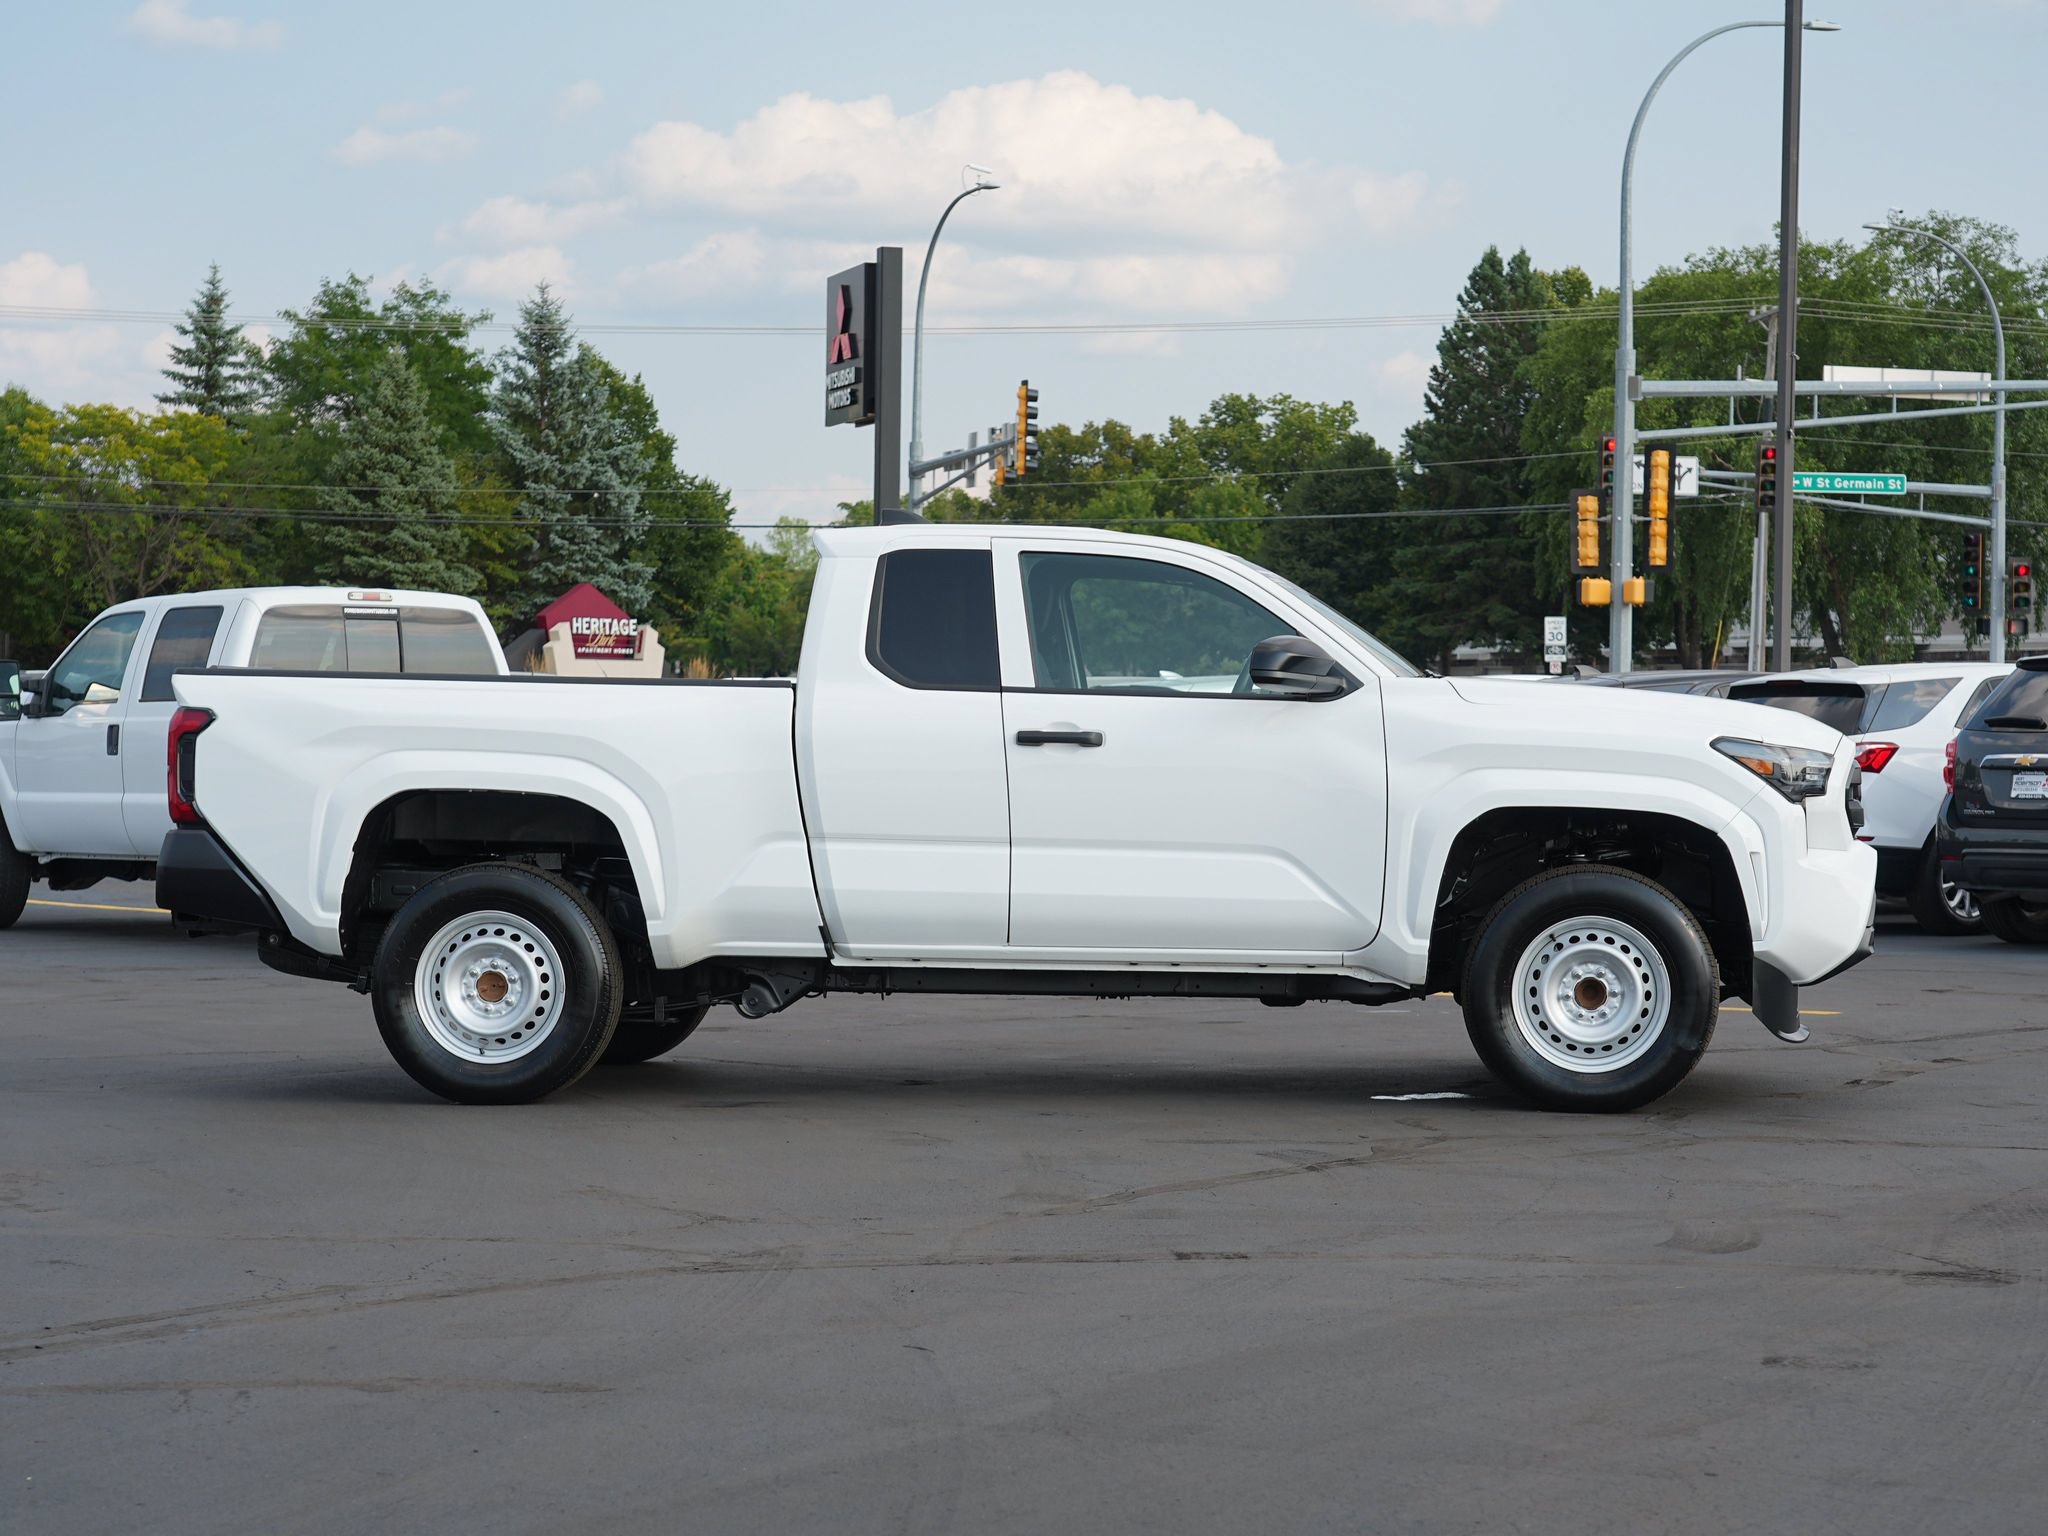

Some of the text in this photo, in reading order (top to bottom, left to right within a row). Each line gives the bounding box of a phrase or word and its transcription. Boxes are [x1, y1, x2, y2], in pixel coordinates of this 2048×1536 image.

[828, 388, 851, 410] MOTORS
[1802, 477, 1902, 489] W St Germain St
[572, 617, 638, 636] HERITAGE
[1548, 632, 1564, 641] 30
